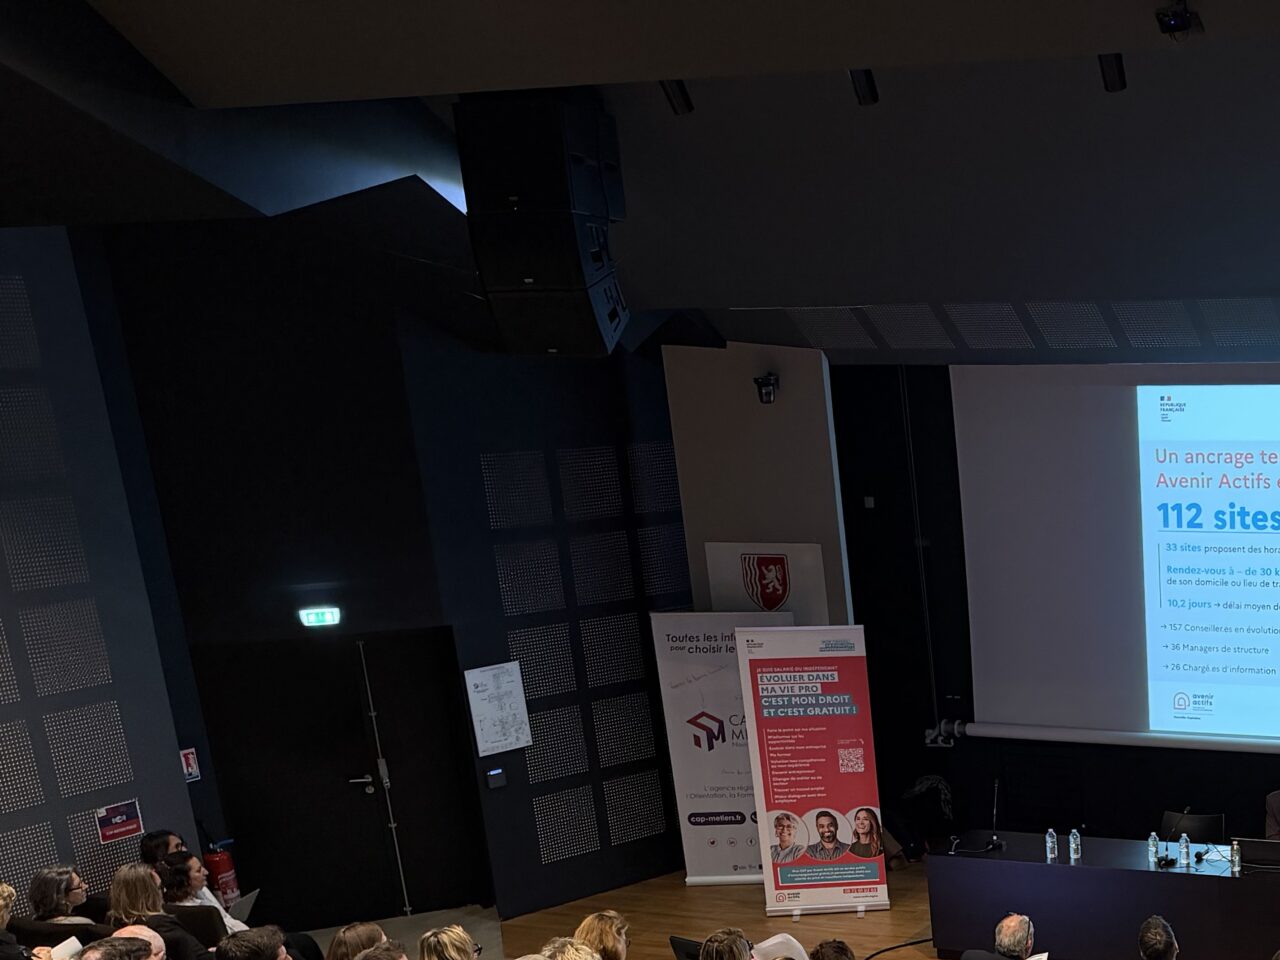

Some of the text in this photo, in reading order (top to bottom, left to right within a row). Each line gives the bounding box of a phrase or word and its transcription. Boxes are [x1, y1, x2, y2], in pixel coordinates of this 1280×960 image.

[1155, 448, 1178, 464] Un
[1184, 451, 1254, 468] ancrage
[1156, 472, 1212, 489] Avenir
[1218, 472, 1271, 490] Actifs
[1157, 502, 1204, 529] 112
[1166, 542, 1178, 552] 33
[1180, 542, 1202, 552] sites
[1204, 545, 1246, 554] proposent
[1248, 545, 1262, 554] des
[1166, 565, 1226, 574] Rendez-vous
[1245, 567, 1257, 576] de
[1260, 568, 1272, 576] 30
[1166, 577, 1177, 585] de
[1195, 578, 1228, 586] domicile
[1244, 580, 1258, 588] lieu
[1260, 580, 1270, 588] de
[1168, 599, 1186, 608] 10,2
[1188, 599, 1212, 610] jours
[1222, 601, 1242, 610] délai
[1244, 603, 1272, 612] moyen
[666, 634, 700, 643] Toutes
[704, 633, 718, 642] les
[688, 644, 722, 654] choisir
[1182, 644, 1220, 654] Managers
[1221, 645, 1232, 653] de
[1234, 646, 1270, 654] structure
[760, 672, 836, 682] ÉVOLUER DANS
[761, 684, 818, 694] MA VIE PRO
[762, 696, 850, 706] C'EST MON DROIT
[763, 708, 776, 717] ET
[778, 708, 804, 716] C'EST
[807, 706, 852, 716] GRATUIT
